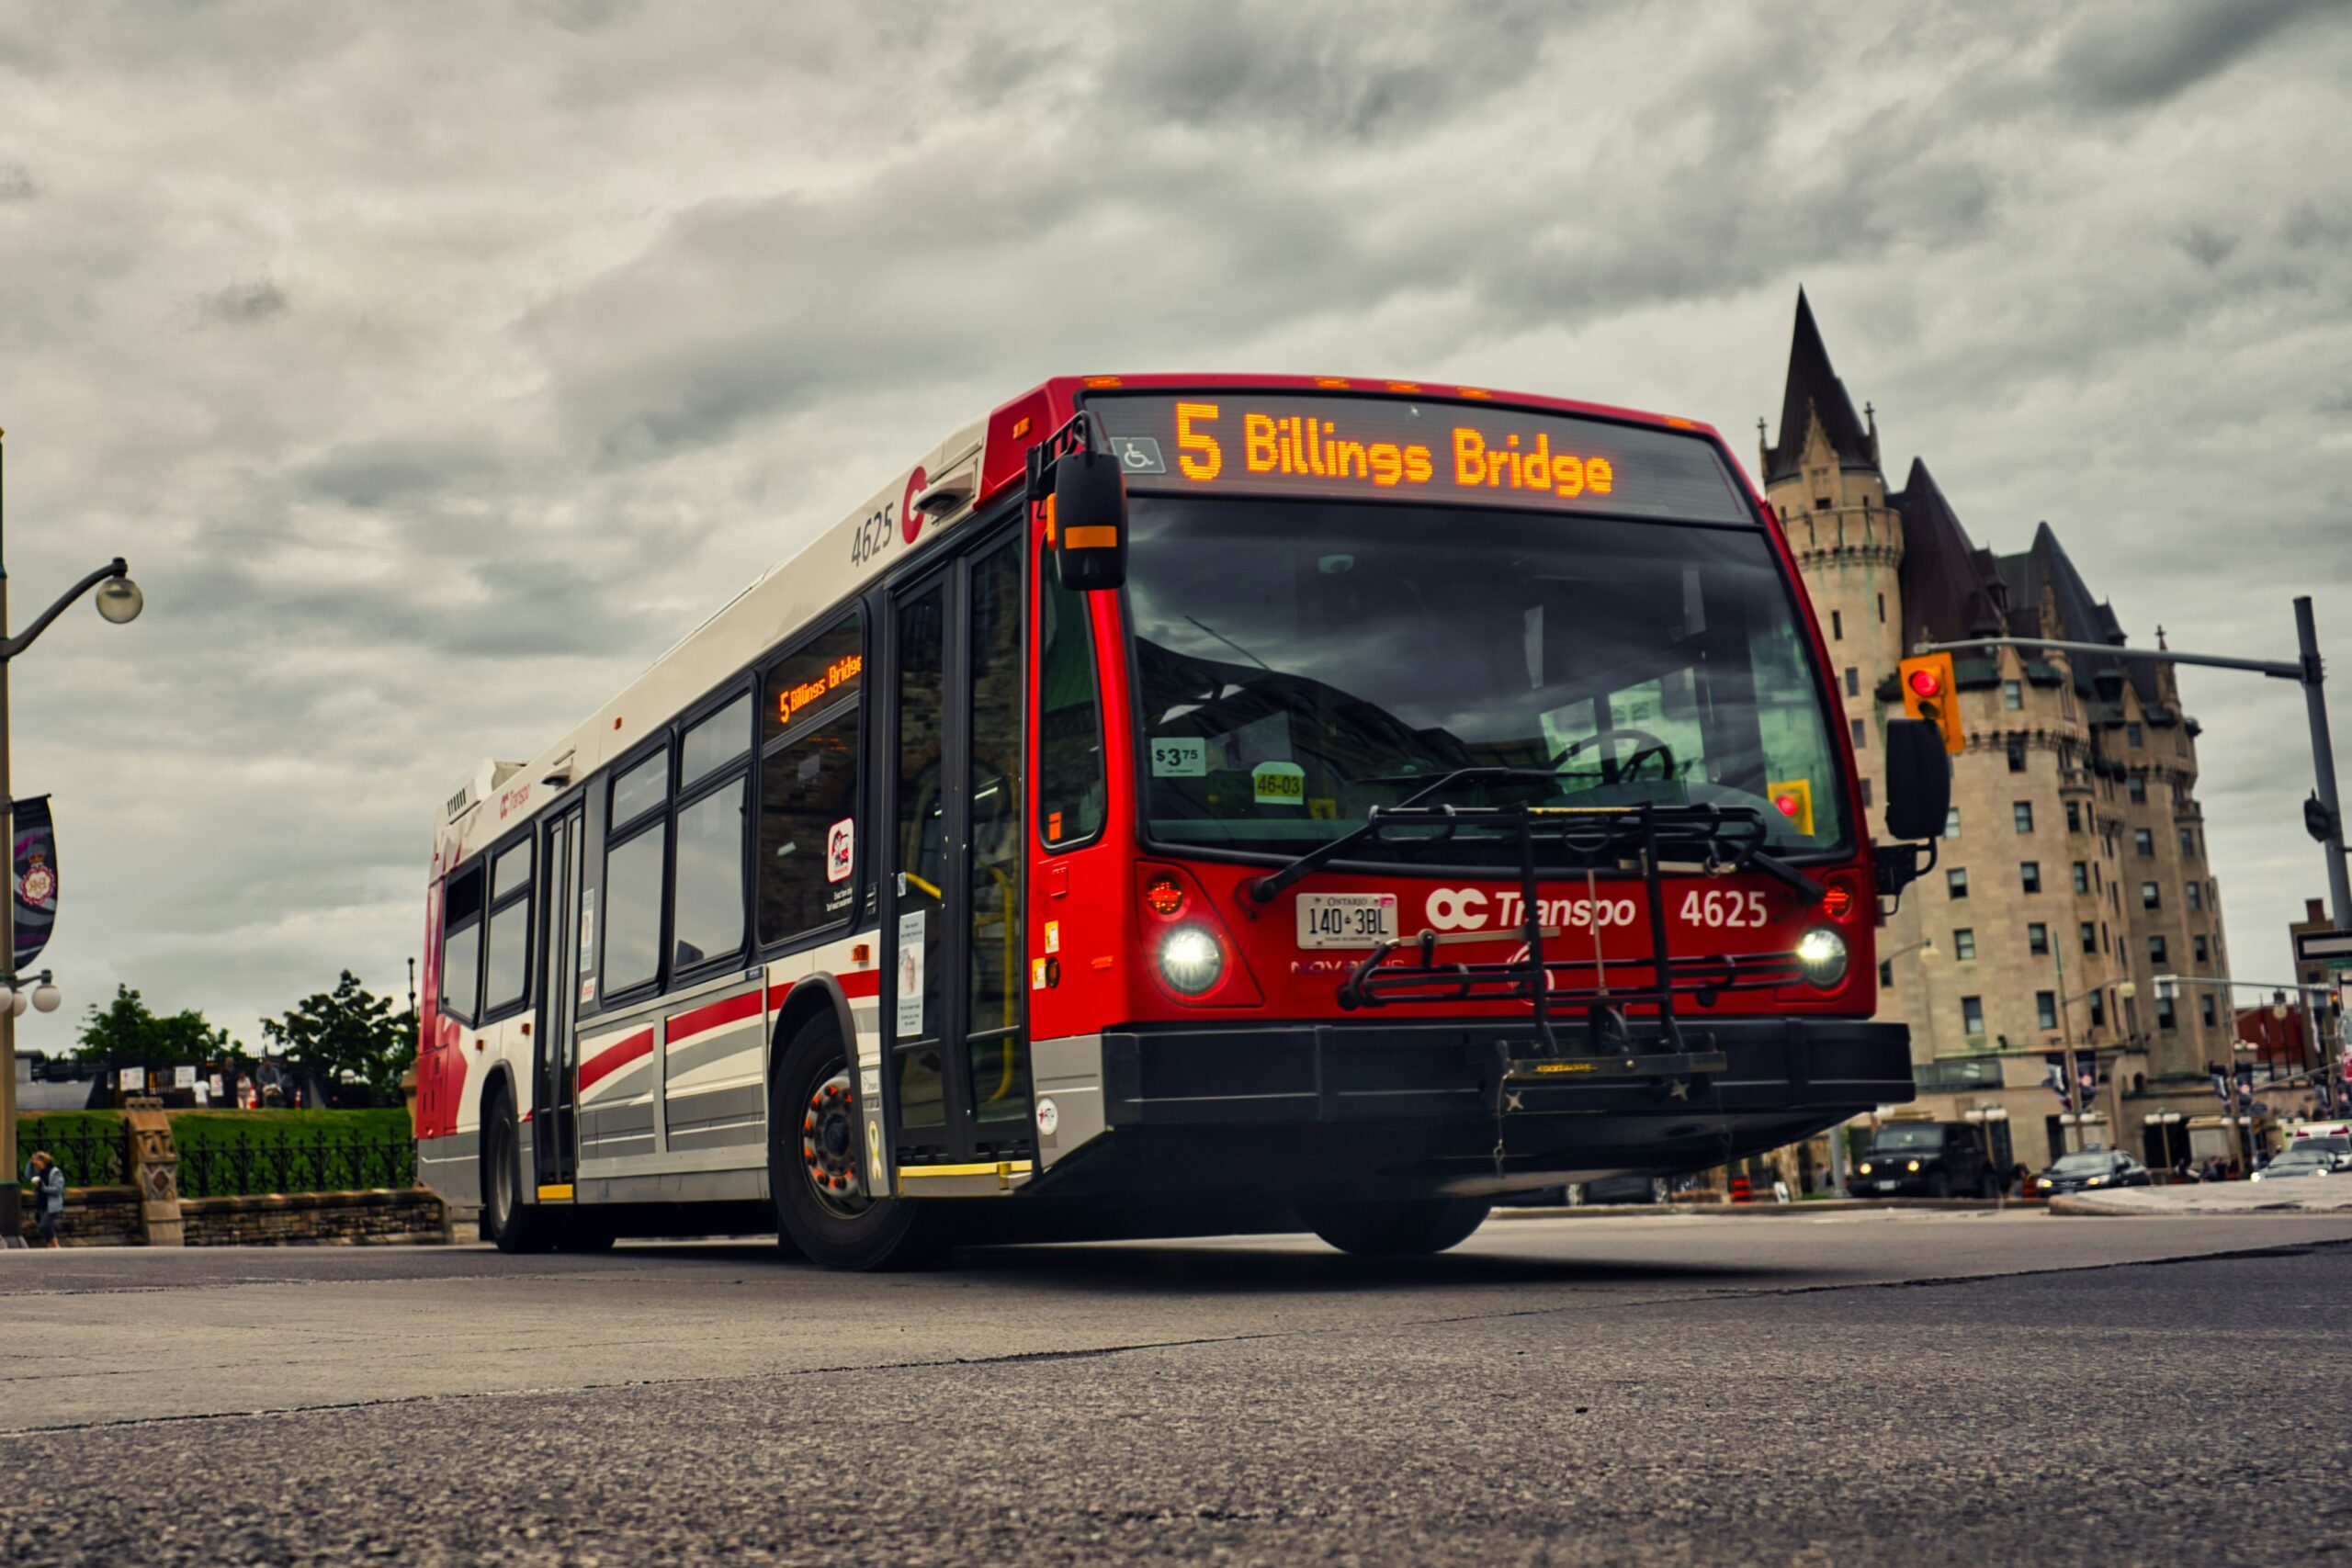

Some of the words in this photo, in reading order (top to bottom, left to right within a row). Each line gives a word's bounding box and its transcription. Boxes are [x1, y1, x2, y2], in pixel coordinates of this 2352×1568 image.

[1175, 402, 1222, 482] 5
[1243, 413, 1433, 487] Billings
[1453, 427, 1613, 499] Bridge
[852, 502, 893, 567] 4625
[780, 691, 790, 723] 5
[790, 679, 826, 712] Billings
[1257, 775, 1300, 794] 46-03
[1425, 888, 1488, 930] OC
[1680, 890, 1768, 928] 4625
